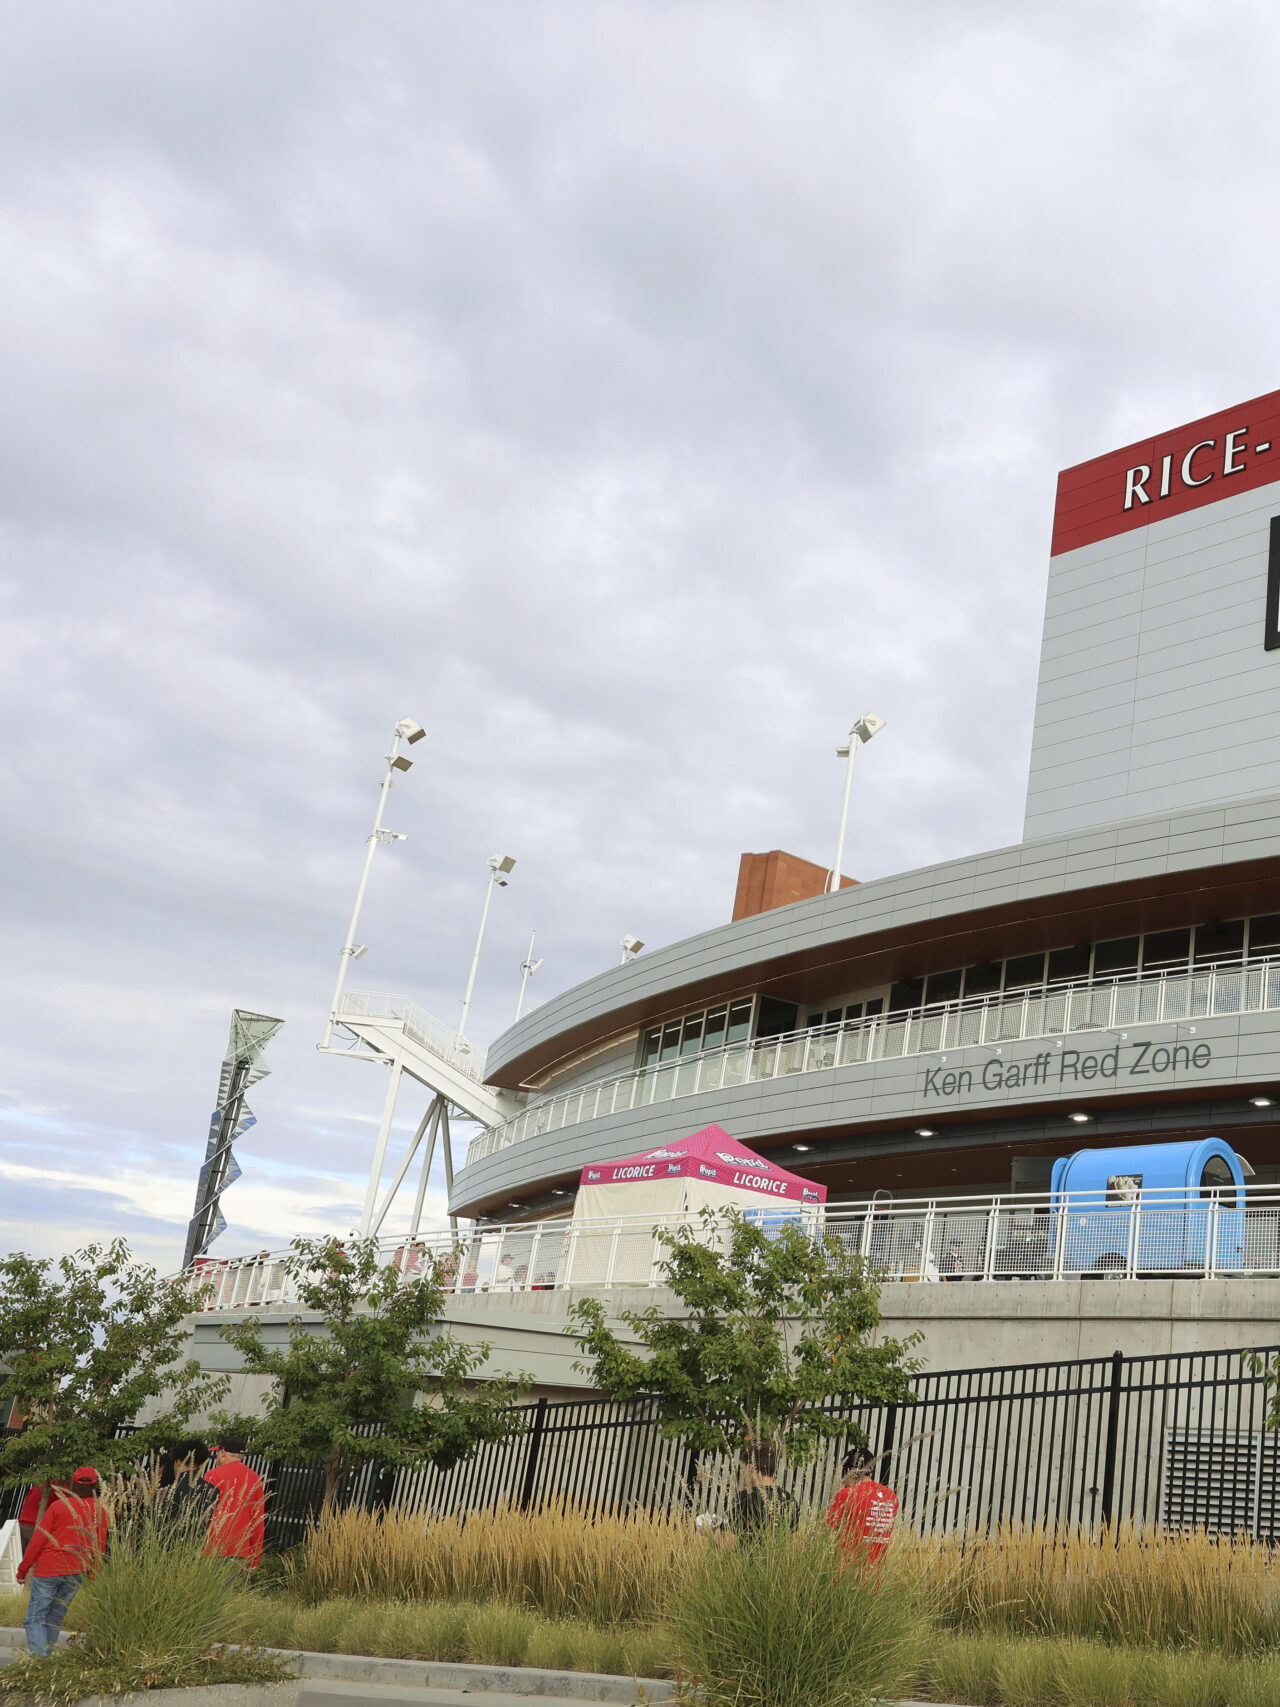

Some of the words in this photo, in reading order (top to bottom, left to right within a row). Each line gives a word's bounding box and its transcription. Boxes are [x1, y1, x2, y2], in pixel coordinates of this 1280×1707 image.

[923, 1067, 973, 1098] Ken
[982, 1051, 1052, 1091] Garff
[1059, 1044, 1120, 1083] Red
[1129, 1041, 1212, 1076] Zone
[612, 1164, 656, 1180] LICORICE
[733, 1171, 788, 1195] LICORICE
